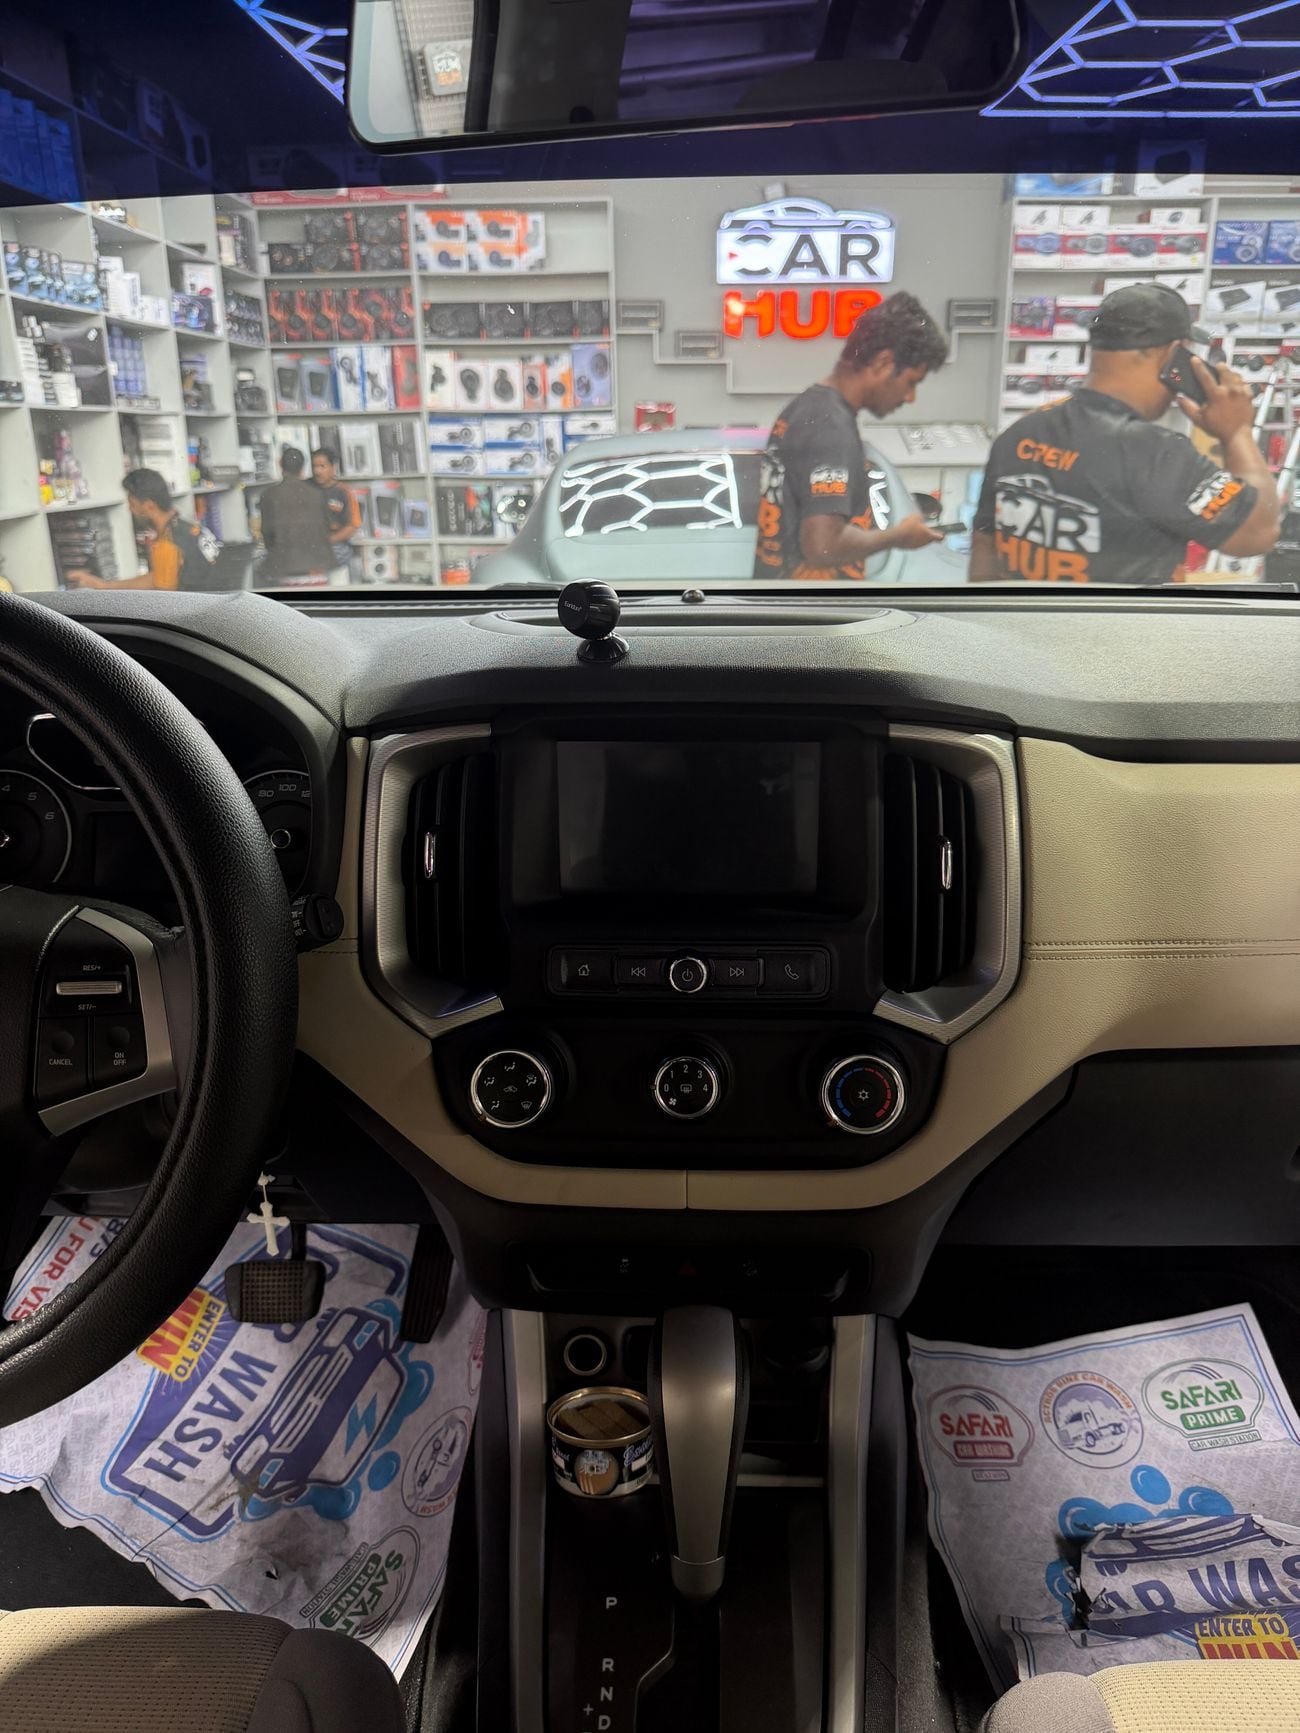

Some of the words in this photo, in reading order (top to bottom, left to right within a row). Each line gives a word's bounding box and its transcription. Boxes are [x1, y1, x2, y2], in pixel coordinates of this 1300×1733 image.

[731, 232, 881, 277] CAR
[995, 531, 1089, 582] HUB
[278, 783, 297, 792] 100
[45, 810, 55, 820] 6
[48, 1058, 73, 1066] CANCEL
[683, 1064, 689, 1073] 2
[670, 1071, 674, 1079] 1
[697, 1070, 703, 1079] 3
[702, 1083, 709, 1092] 4
[42, 1232, 85, 1280] FOR
[188, 1300, 221, 1353] ENTER
[175, 1356, 195, 1377] TO
[1161, 1379, 1243, 1410] SAFARI
[143, 1351, 277, 1482] WASH
[939, 1413, 1014, 1438] SAFARI
[1186, 1408, 1239, 1428] PRIME
[329, 1562, 377, 1620] PRIME
[605, 1596, 618, 1609] P
[1200, 1617, 1256, 1637] ENTER
[1257, 1617, 1285, 1635] TO
[602, 1659, 615, 1672] R
[600, 1686, 613, 1702] N
[597, 1714, 611, 1731] D
